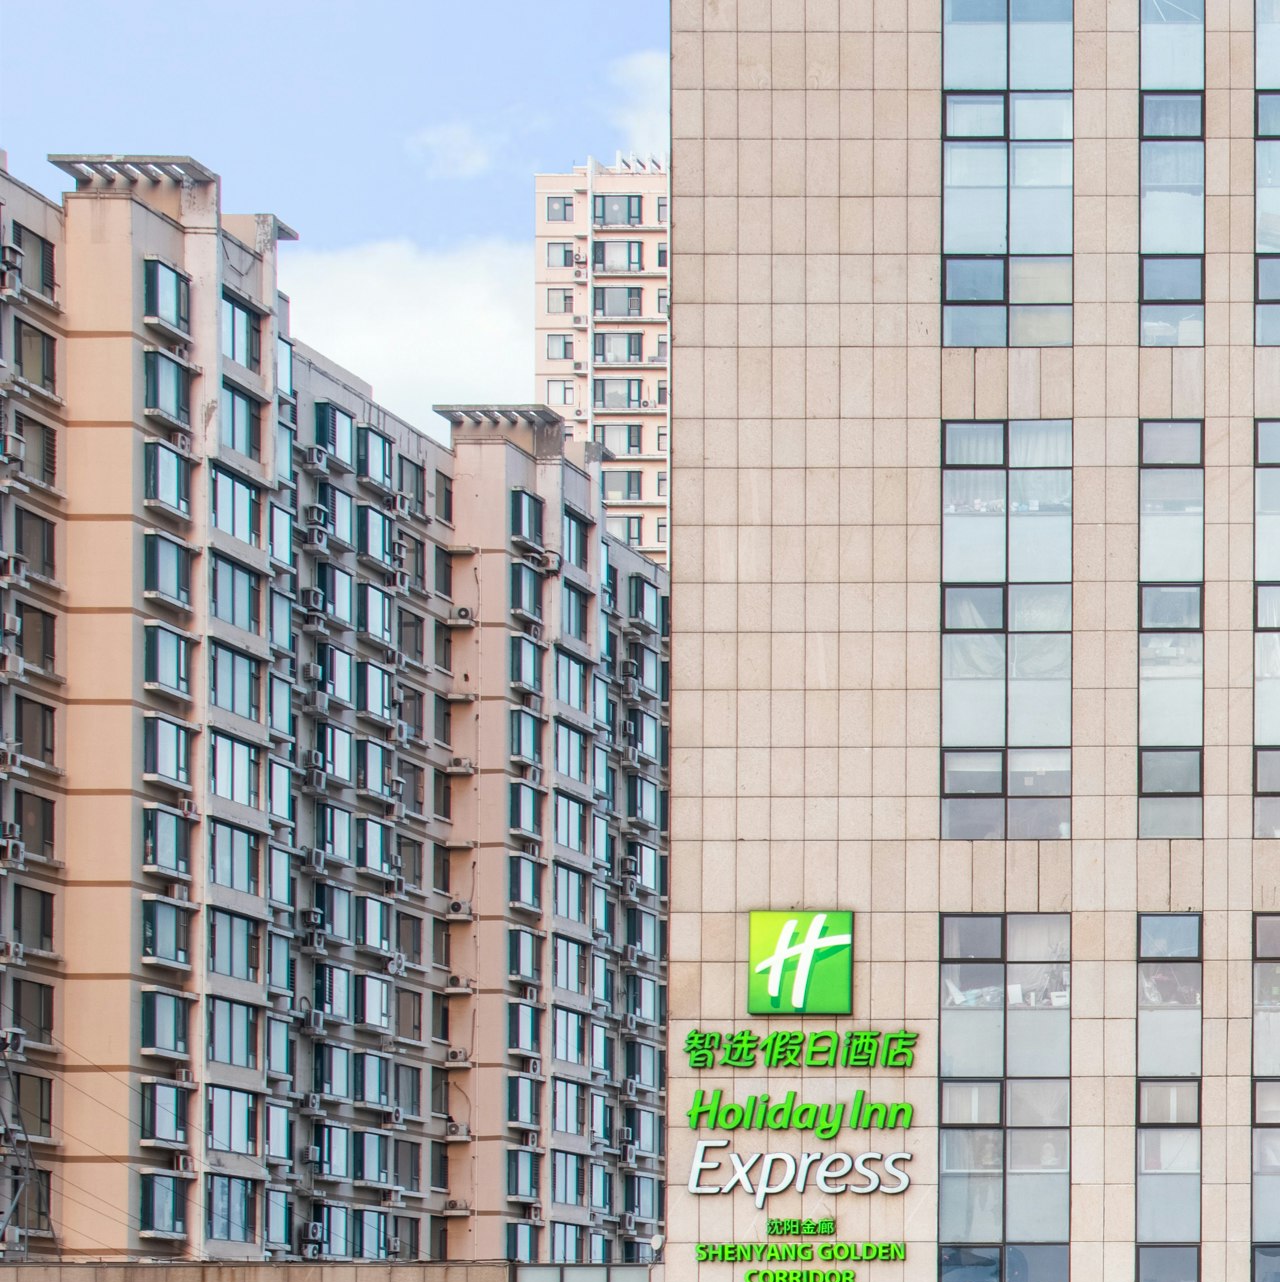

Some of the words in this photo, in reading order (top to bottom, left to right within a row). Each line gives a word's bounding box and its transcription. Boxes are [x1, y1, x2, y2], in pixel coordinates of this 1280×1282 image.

[683, 1029, 919, 1068] 智选假日酒店
[686, 1089, 845, 1140] Holiday
[849, 1090, 913, 1130] Inn
[687, 1139, 913, 1210] Express
[766, 1217, 836, 1236] 沈阳金廊
[695, 1243, 813, 1262] SHENYANG
[817, 1243, 906, 1261] GOLDEN
